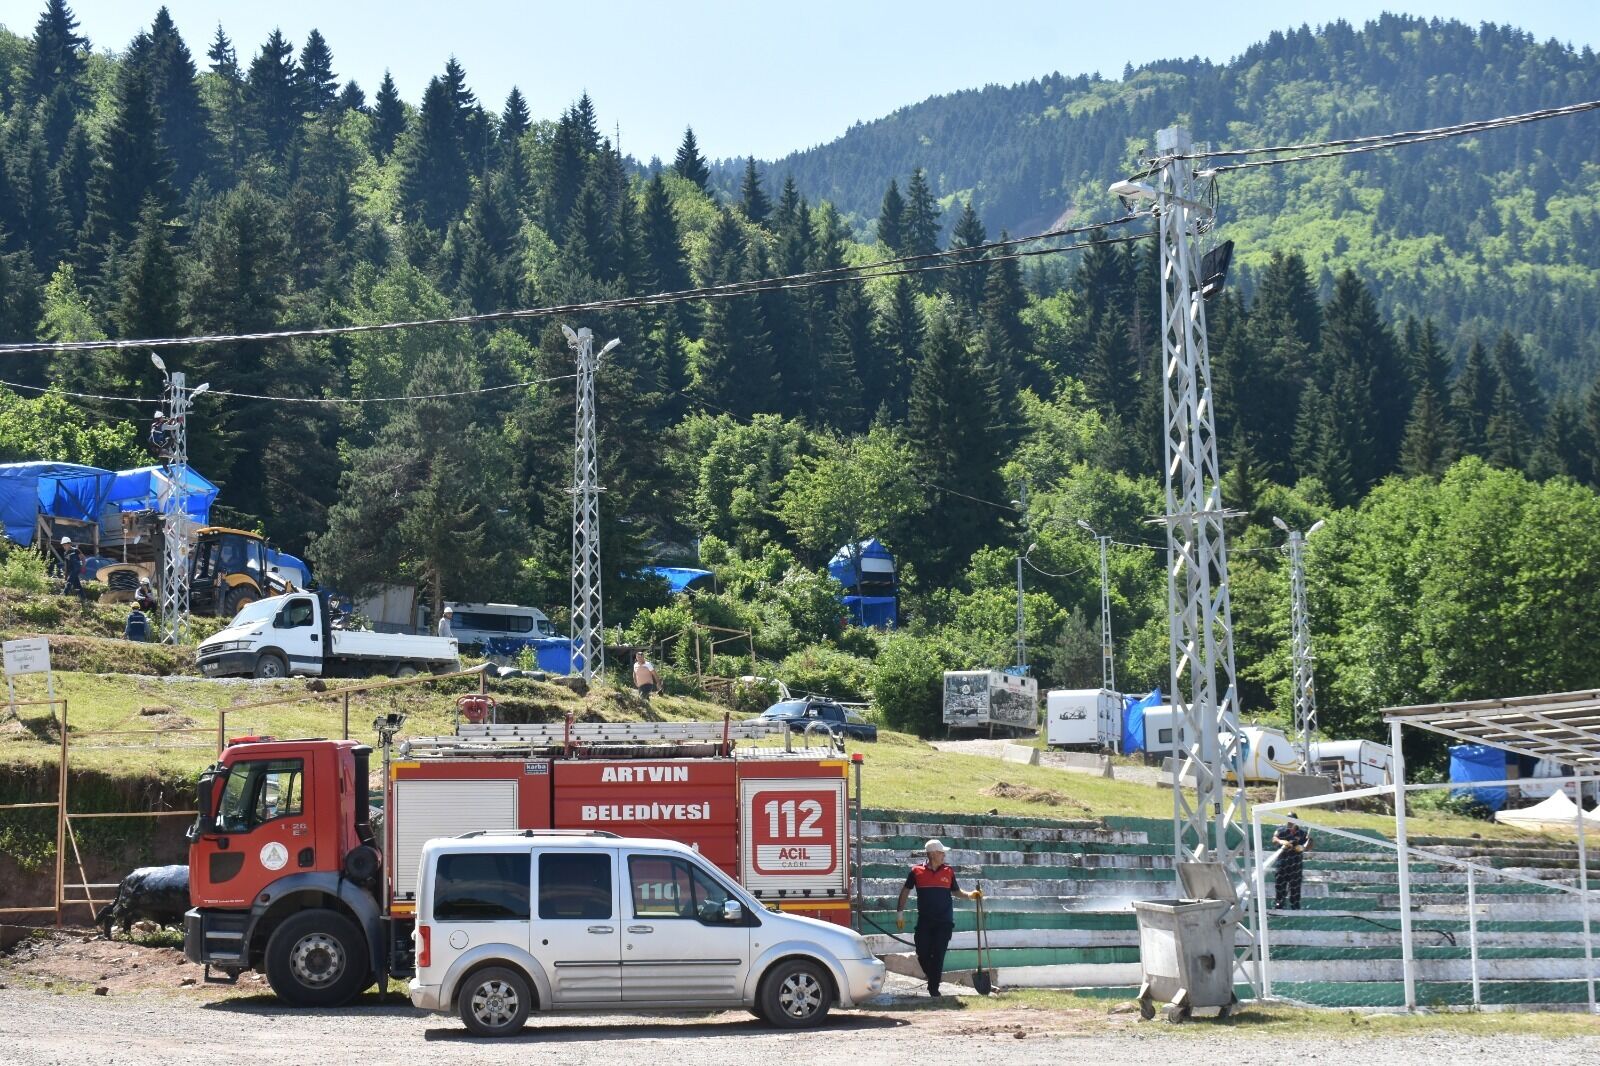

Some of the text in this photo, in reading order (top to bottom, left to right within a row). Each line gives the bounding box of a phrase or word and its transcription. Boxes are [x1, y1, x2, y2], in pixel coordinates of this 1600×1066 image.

[601, 766, 689, 782] ARTVIN
[581, 802, 710, 821] BELEDİYESİ
[764, 799, 824, 838] 112
